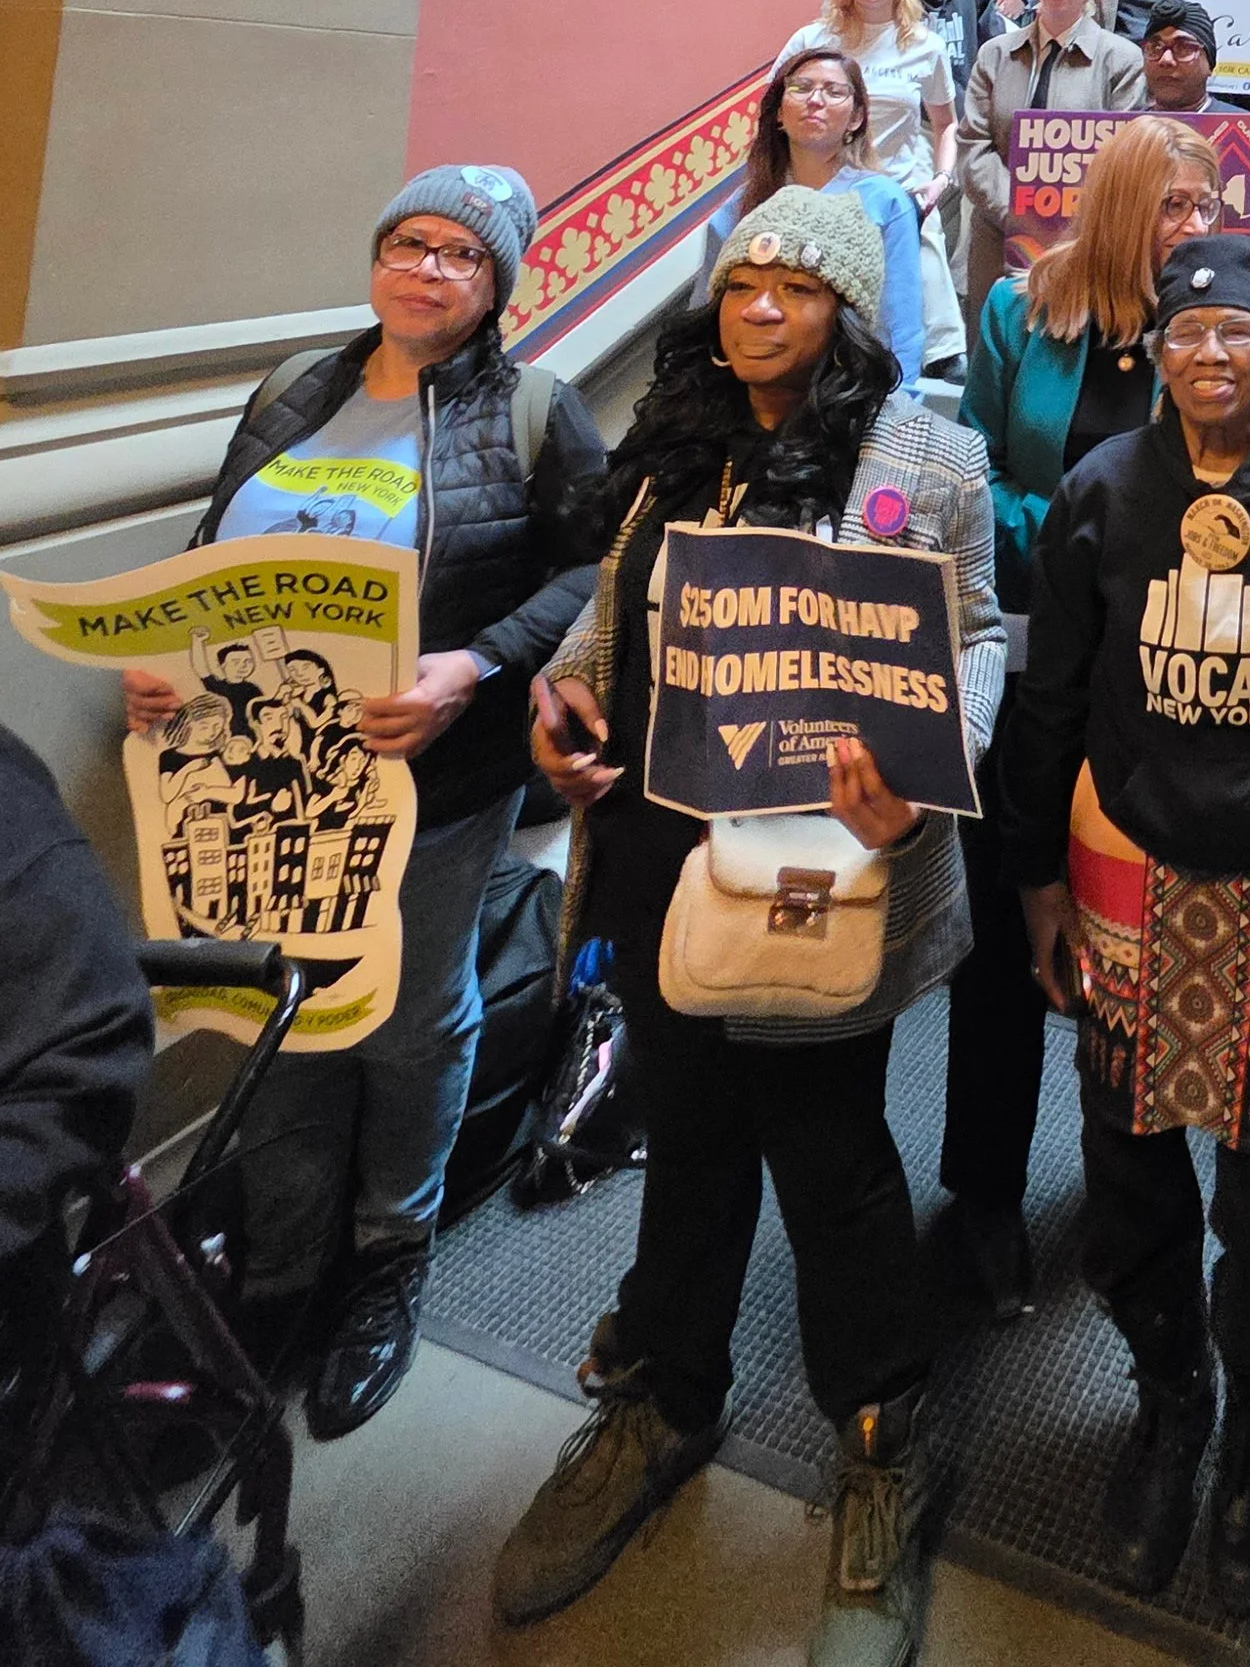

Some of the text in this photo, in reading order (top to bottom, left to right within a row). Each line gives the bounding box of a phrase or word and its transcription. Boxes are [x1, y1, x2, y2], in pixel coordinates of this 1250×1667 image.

[1019, 118, 1130, 150] HOUS
[269, 459, 417, 494] MAKE THE ROAD
[336, 483, 404, 506] NEW YORK
[78, 573, 388, 637] MAKE THE ROAD
[223, 602, 386, 631] NEW YORK
[680, 582, 771, 629] $250M
[779, 586, 837, 630] FOR
[665, 646, 949, 713] END HOMELESSNESS
[1146, 692, 1202, 725] NEW
[779, 718, 858, 735] Volunteers
[779, 735, 798, 752] of
[318, 1005, 361, 1026] PODER
